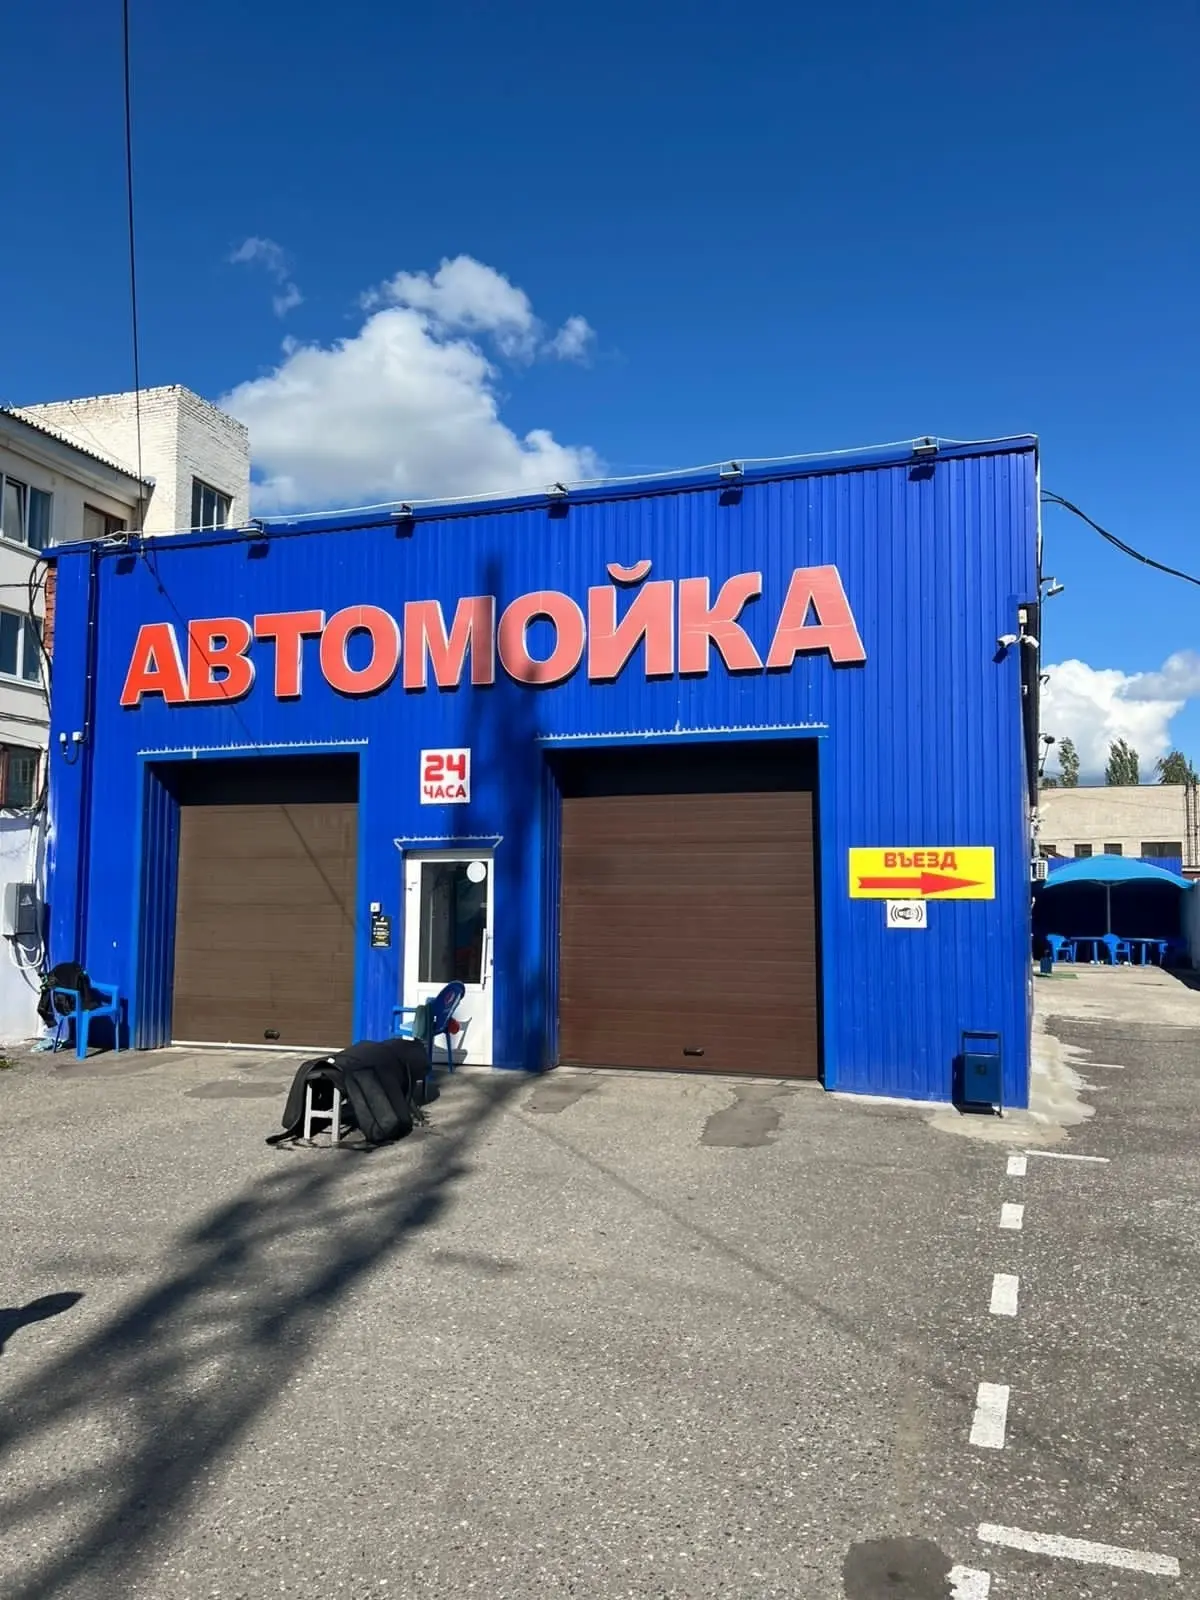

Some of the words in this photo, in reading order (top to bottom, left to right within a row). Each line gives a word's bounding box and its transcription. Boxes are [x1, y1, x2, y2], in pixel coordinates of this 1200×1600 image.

[119, 559, 866, 706] АВТОМОЙКА
[425, 754, 466, 781] 24
[424, 785, 466, 798] ЧАСА
[884, 851, 958, 870] ВЪЕЗД
